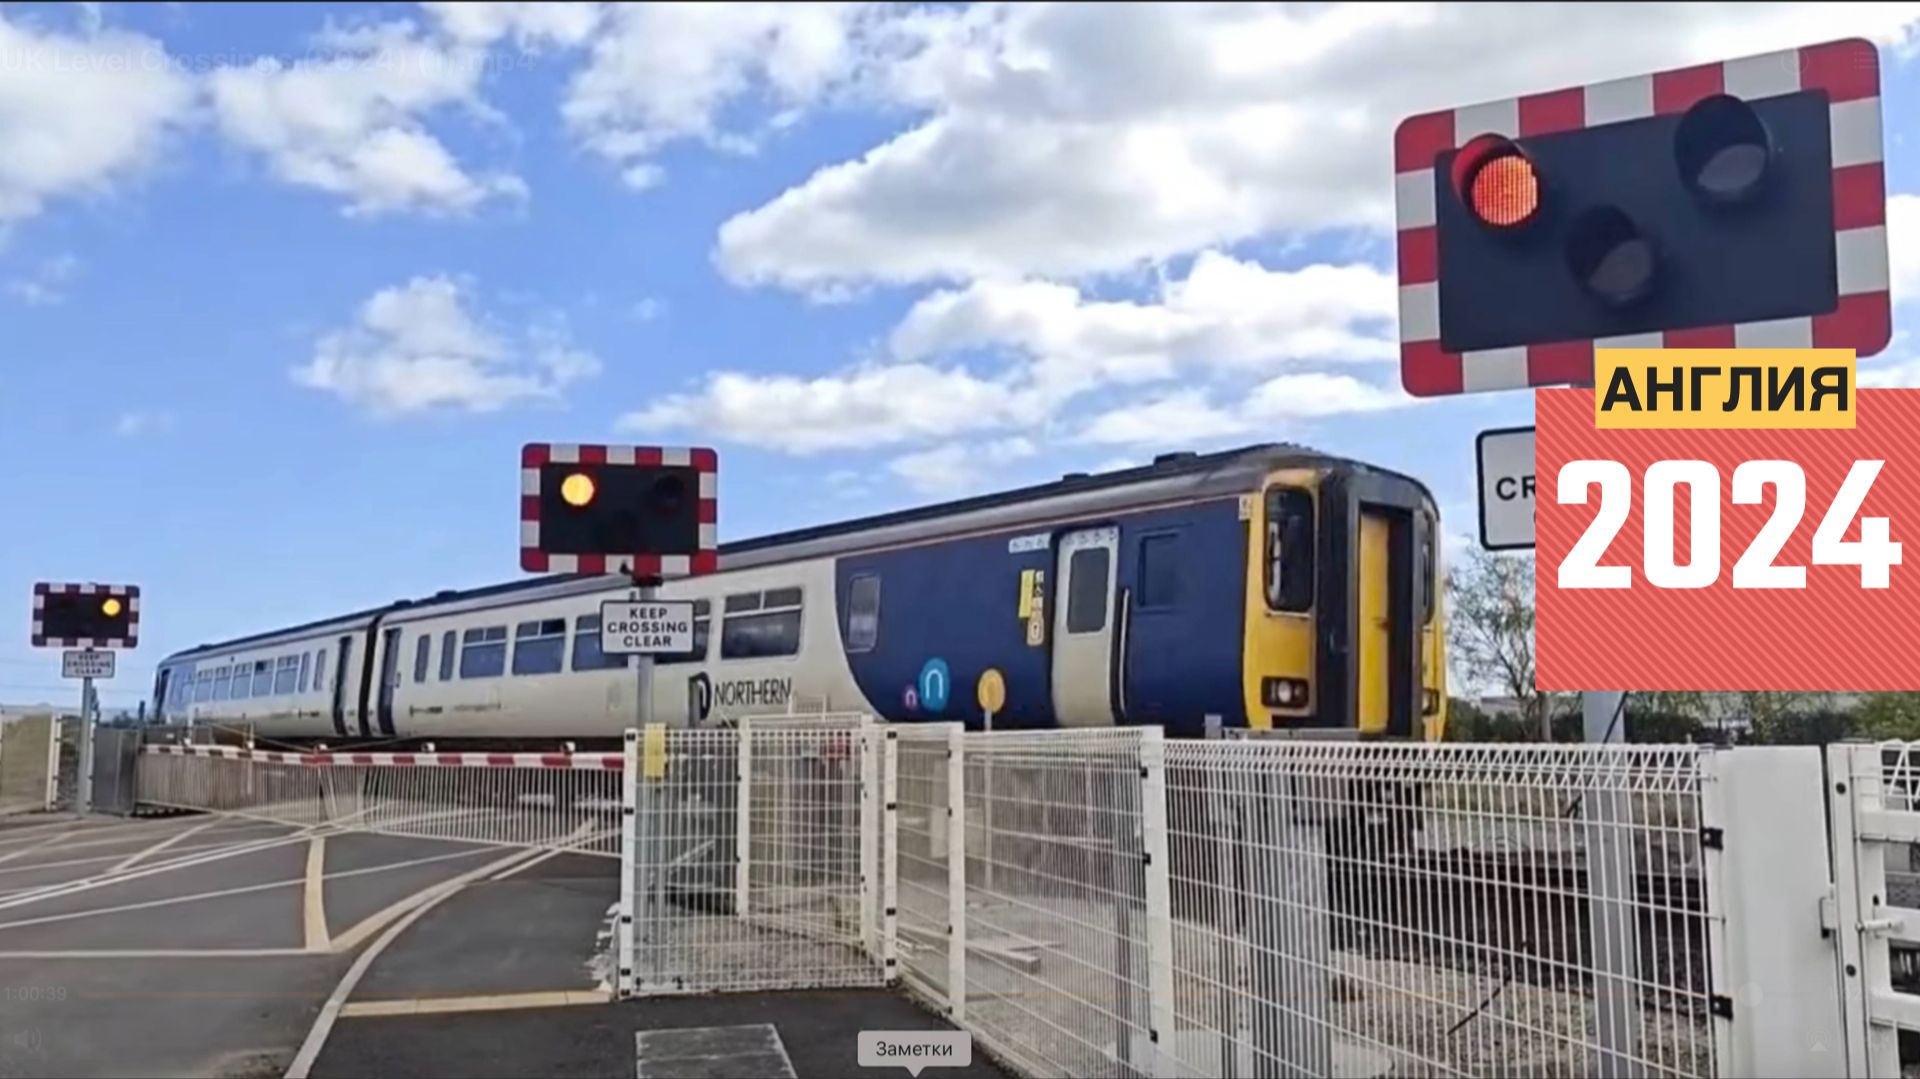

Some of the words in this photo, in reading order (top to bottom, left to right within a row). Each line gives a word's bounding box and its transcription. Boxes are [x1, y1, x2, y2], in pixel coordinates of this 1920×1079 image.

[629, 607, 668, 619] KEEP
[607, 621, 688, 633] CROSSING
[623, 635, 672, 647] CLEAR
[714, 678, 792, 706] NORTHERN
